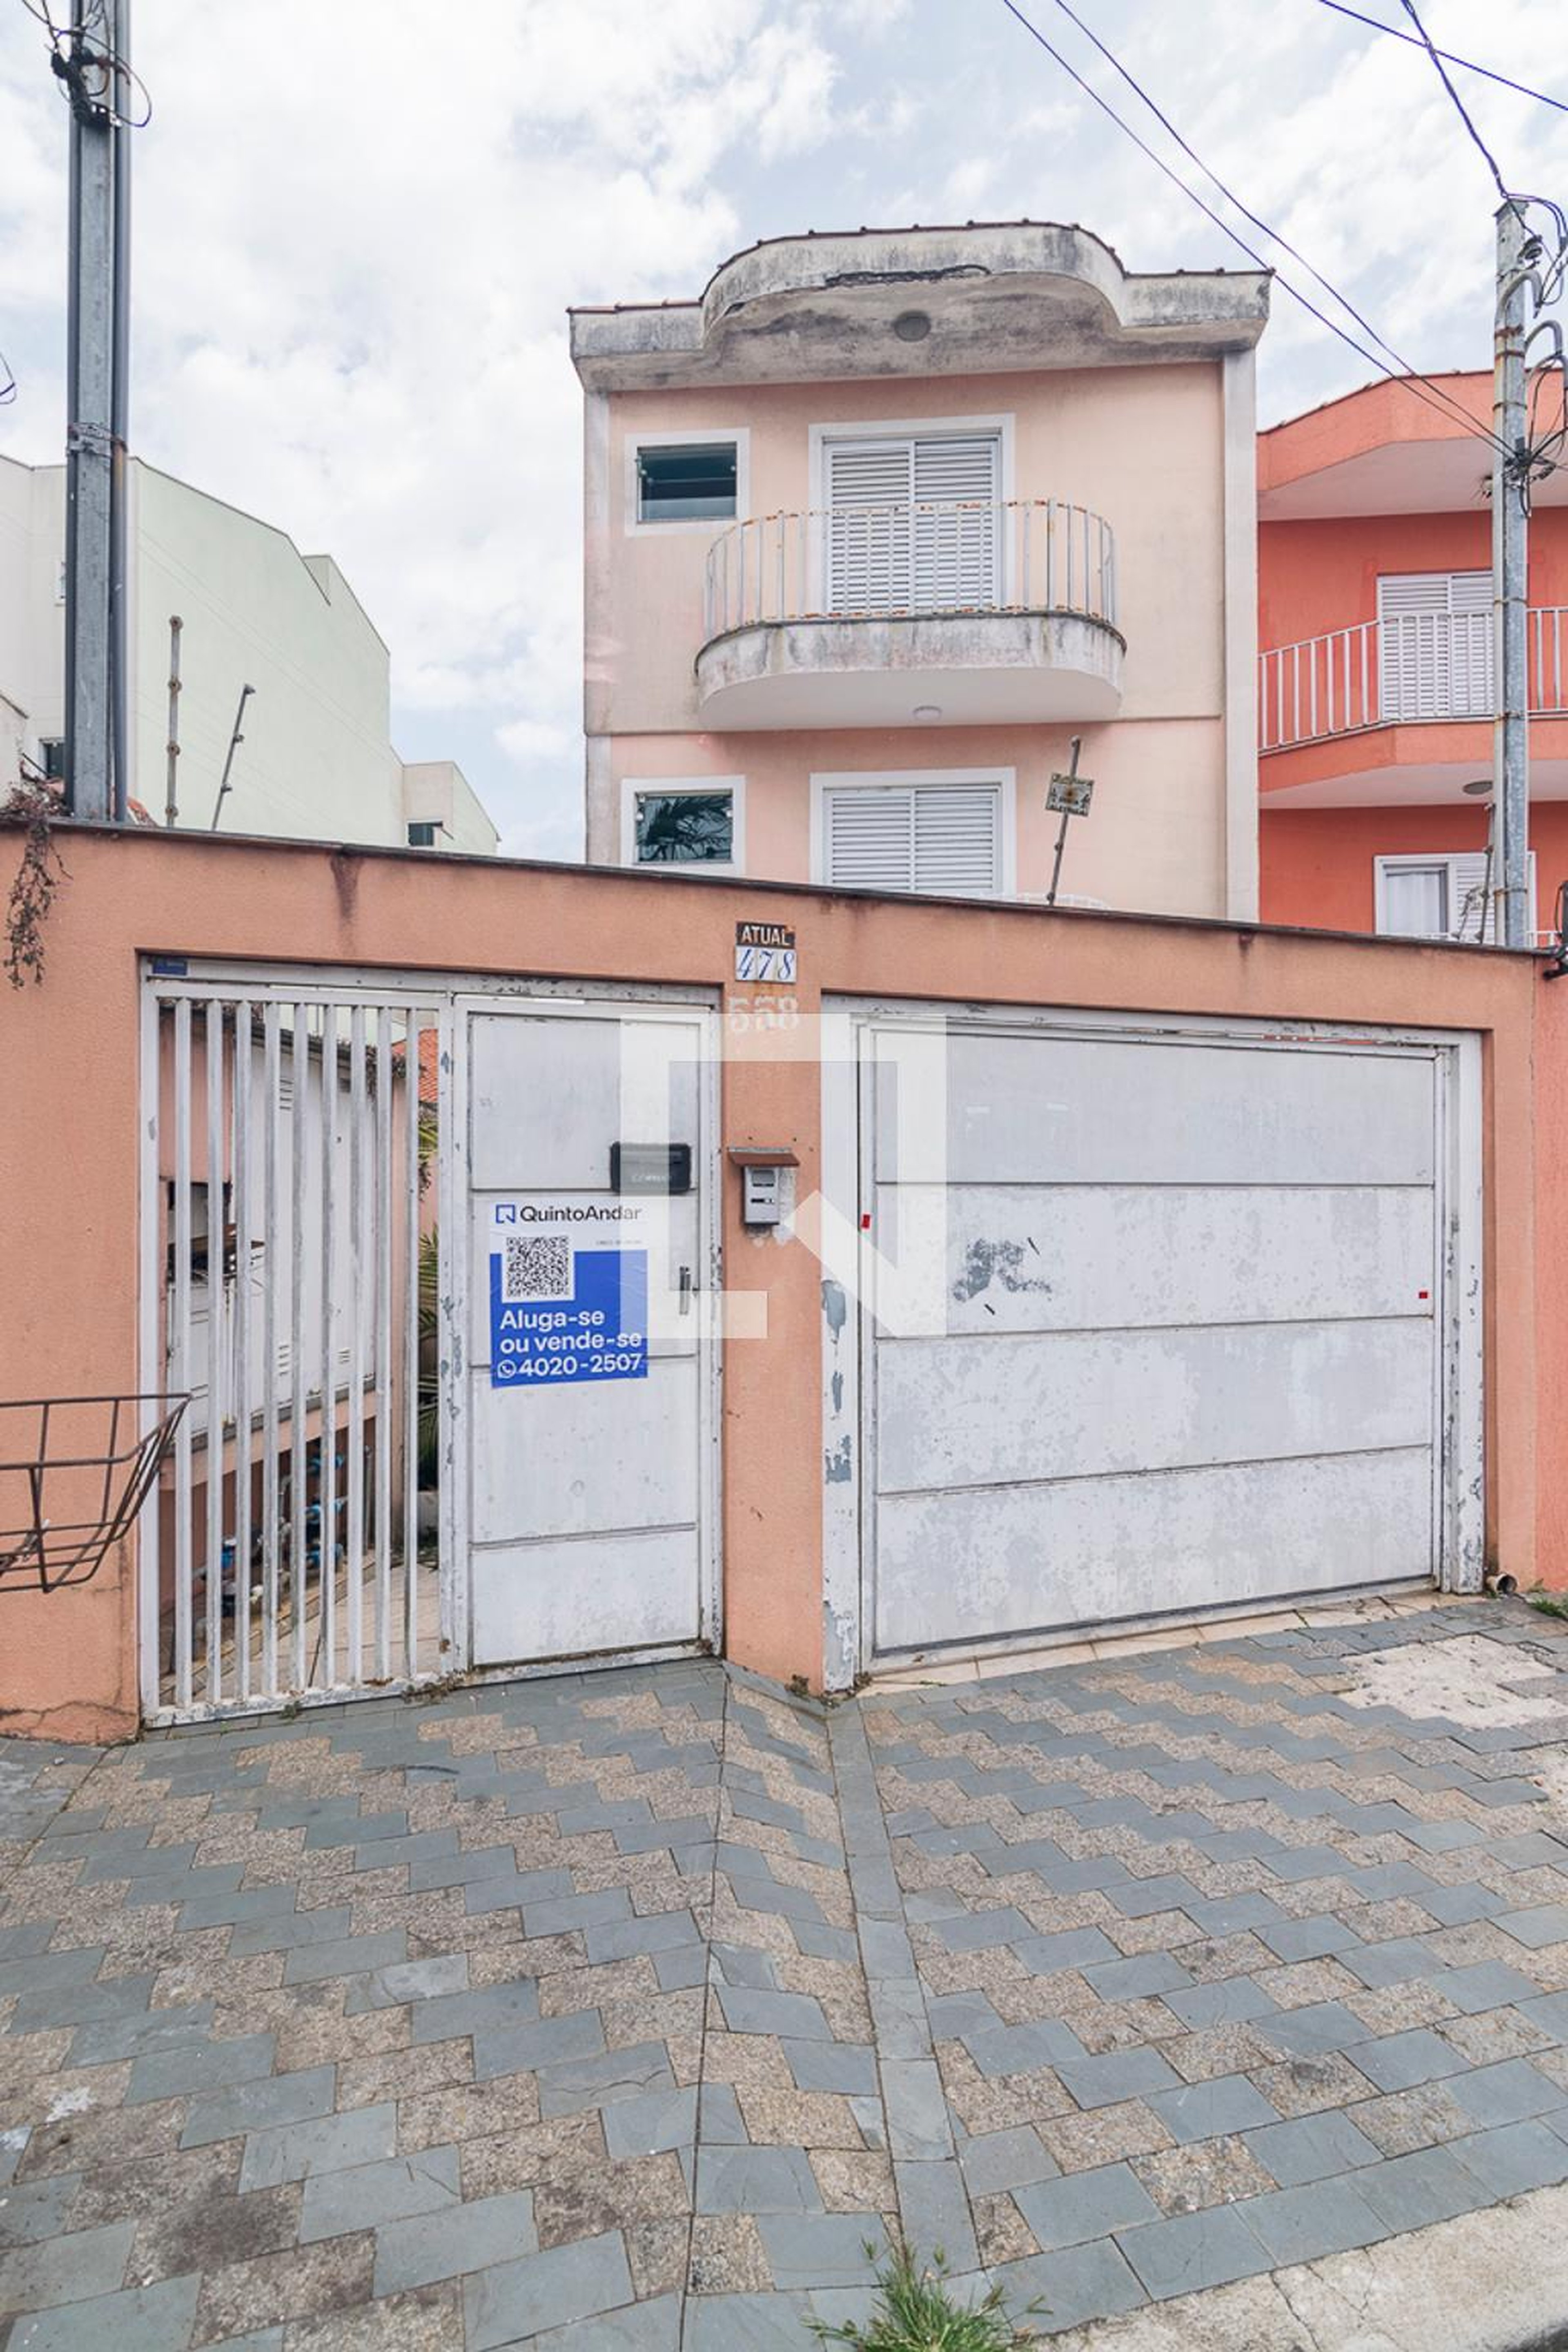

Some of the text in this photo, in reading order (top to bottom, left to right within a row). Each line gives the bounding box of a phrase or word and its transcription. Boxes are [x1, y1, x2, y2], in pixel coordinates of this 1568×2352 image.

[741, 925, 790, 946] ATUAL
[737, 949, 794, 980] 478
[520, 1205, 642, 1222] QuintoAndar
[500, 1310, 605, 1332] Aluga-se
[500, 1330, 641, 1354] ou vende-se
